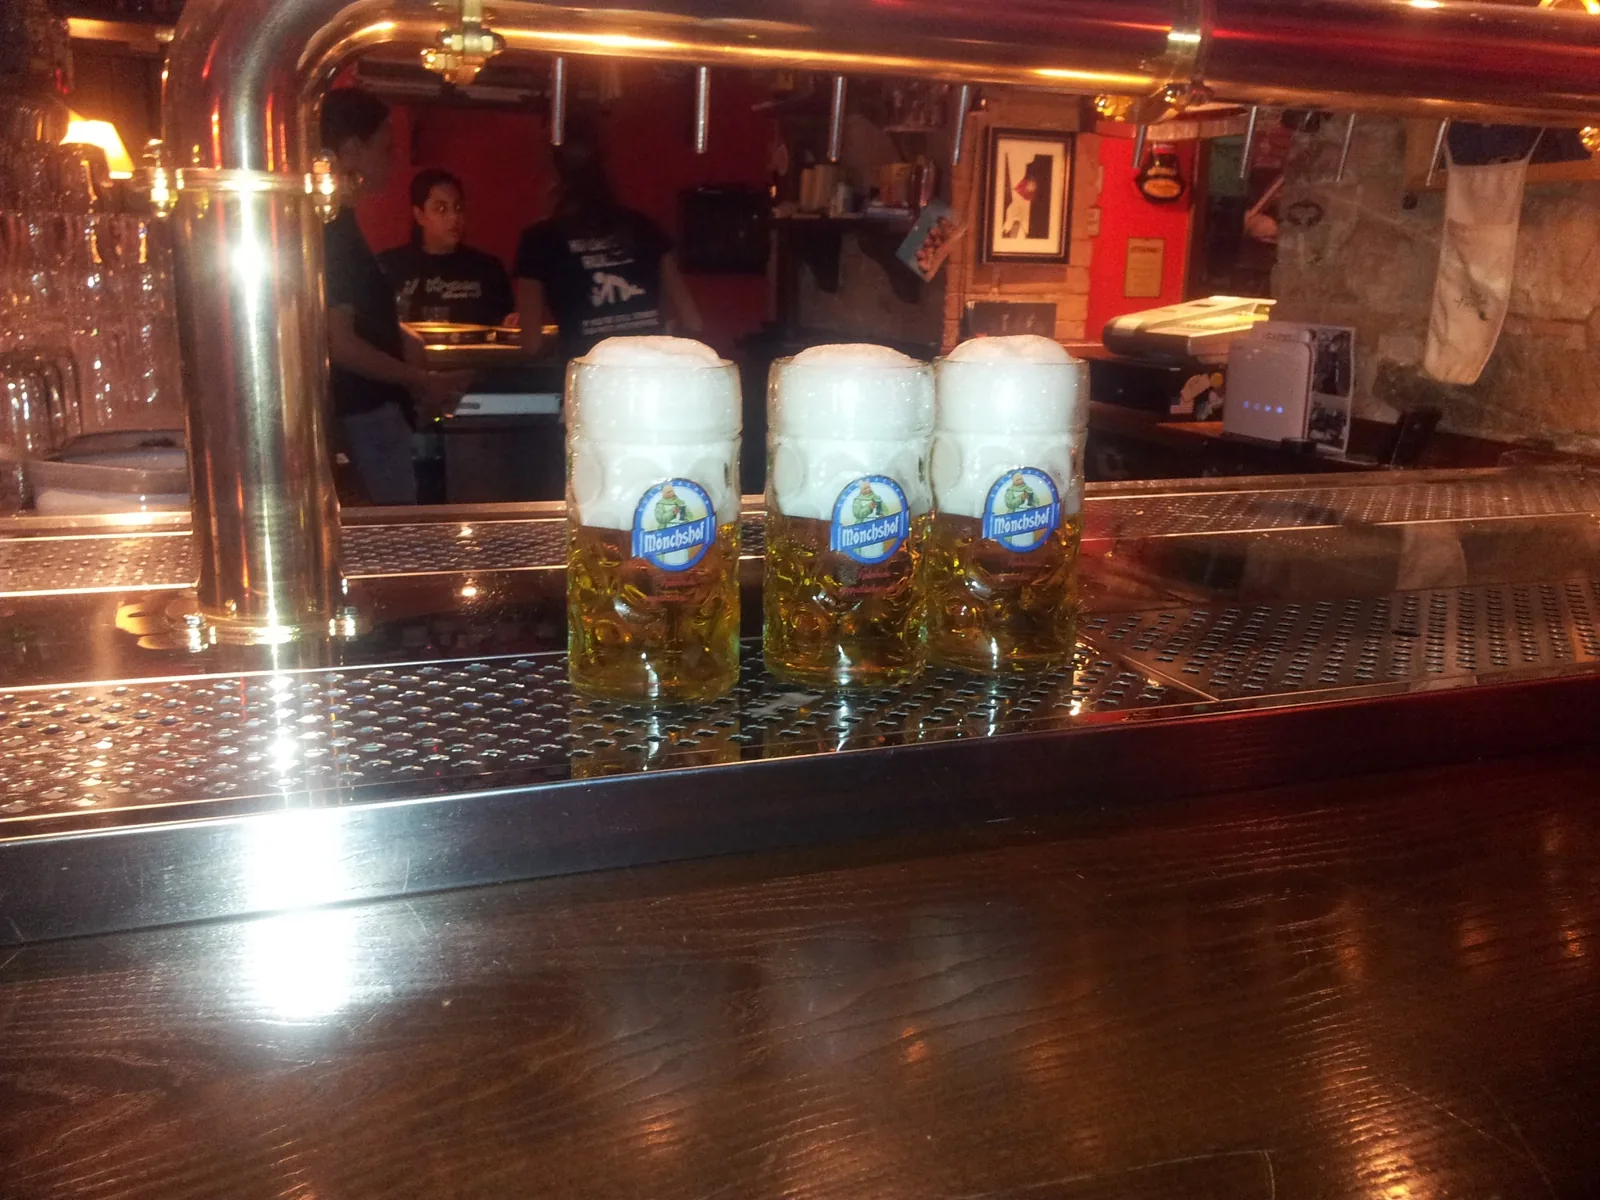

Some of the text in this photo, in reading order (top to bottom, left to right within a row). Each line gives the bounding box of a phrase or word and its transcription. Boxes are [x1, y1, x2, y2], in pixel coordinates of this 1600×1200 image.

[842, 516, 900, 547] Mönchshof
[993, 507, 1051, 535] Mönchshof
[643, 521, 705, 553] Mönchshof
